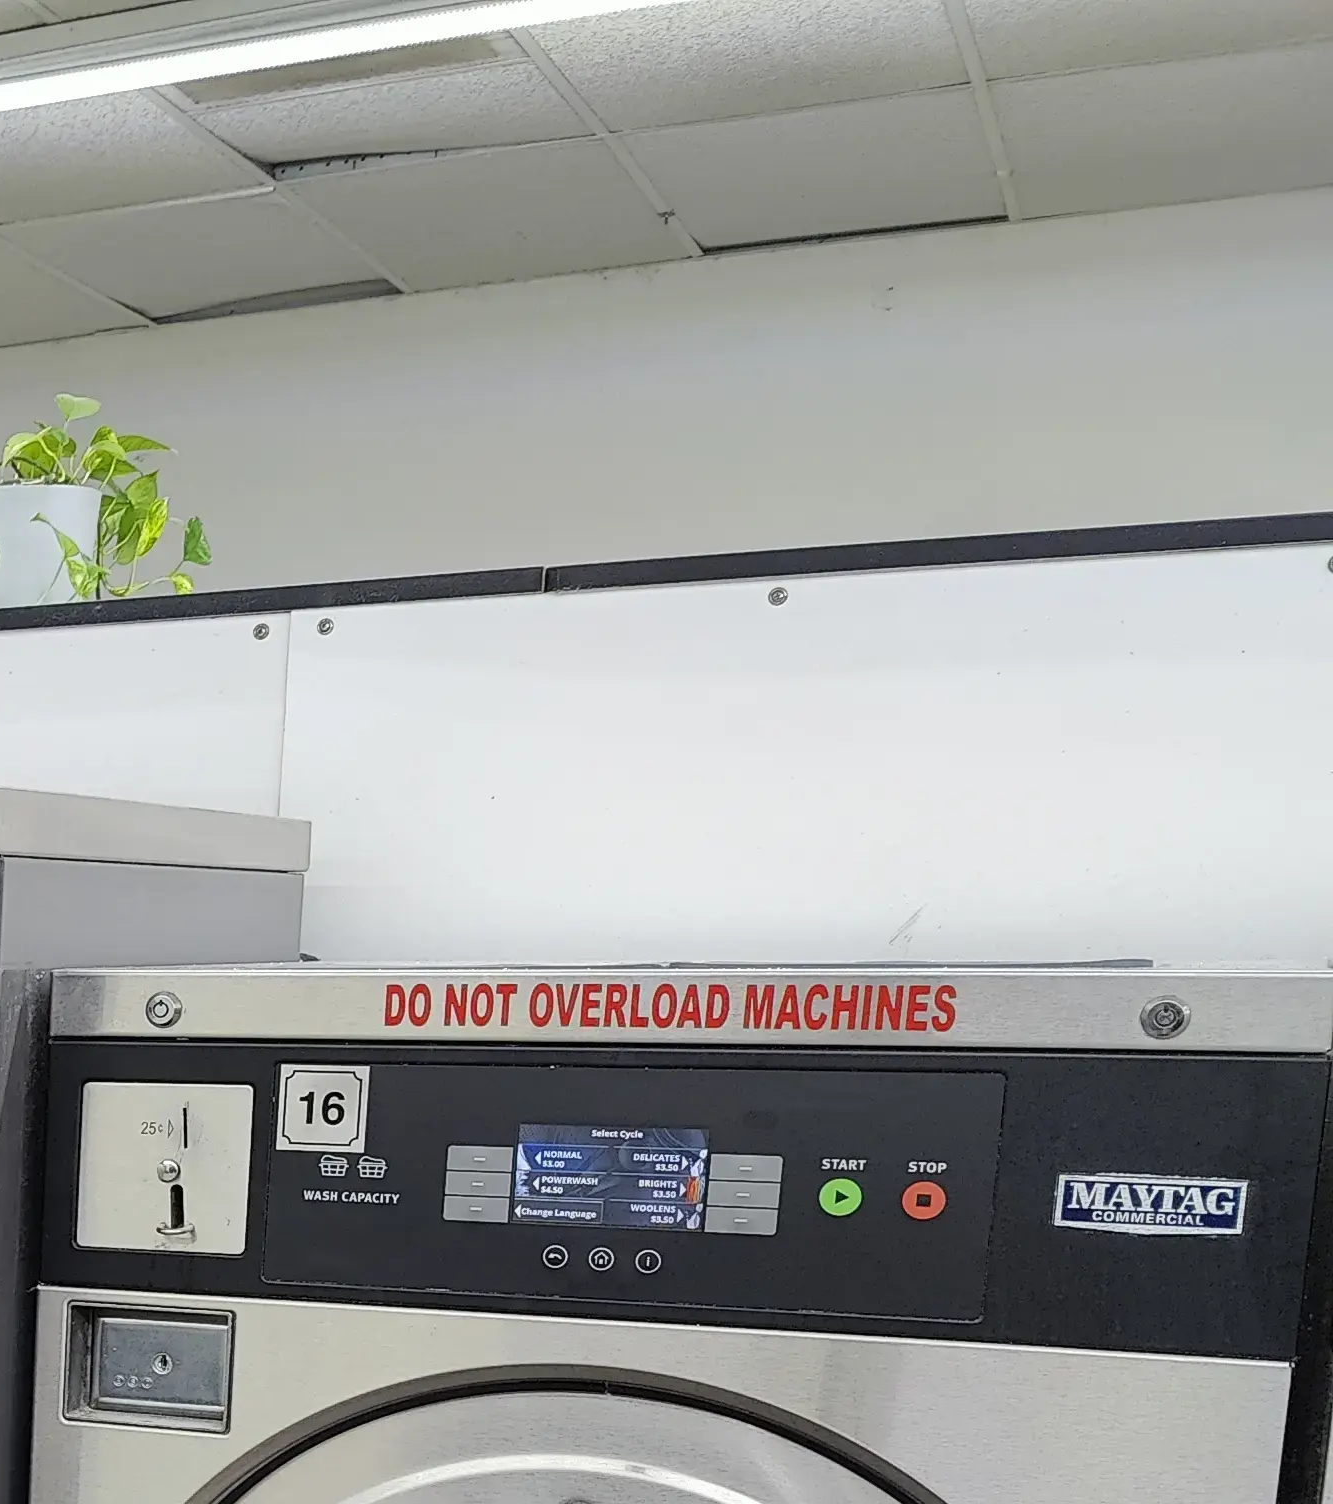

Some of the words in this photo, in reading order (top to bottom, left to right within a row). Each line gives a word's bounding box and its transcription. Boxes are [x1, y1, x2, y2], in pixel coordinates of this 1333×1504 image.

[384, 984, 430, 1027] DO
[443, 983, 517, 1027] NOT
[529, 983, 729, 1029] OVERLOAD
[742, 983, 956, 1032] MACHINES
[299, 1091, 346, 1125] 16
[140, 1121, 164, 1135] 25¢
[591, 1129, 618, 1139] Select
[619, 1130, 644, 1140] Cycle
[543, 1150, 583, 1160] NORMAL
[633, 1153, 681, 1163] DELICATES
[542, 1160, 565, 1169] $3.00
[655, 1163, 679, 1172] $3.50
[821, 1158, 867, 1171] START
[908, 1161, 948, 1174] STOP
[541, 1176, 599, 1186] POWERWASH
[638, 1179, 678, 1189] BRIGHTS
[540, 1185, 564, 1195] $4.50
[652, 1189, 677, 1199] $3.50
[303, 1189, 338, 1202] WASH
[341, 1191, 400, 1205] CAPACITY
[1067, 1181, 1235, 1216] MAYTAG
[521, 1207, 553, 1219] Change
[554, 1208, 597, 1220] Language
[630, 1203, 676, 1214] WOOLENS
[650, 1215, 675, 1224] $3.50
[1092, 1211, 1204, 1226] COMMERCIAL
